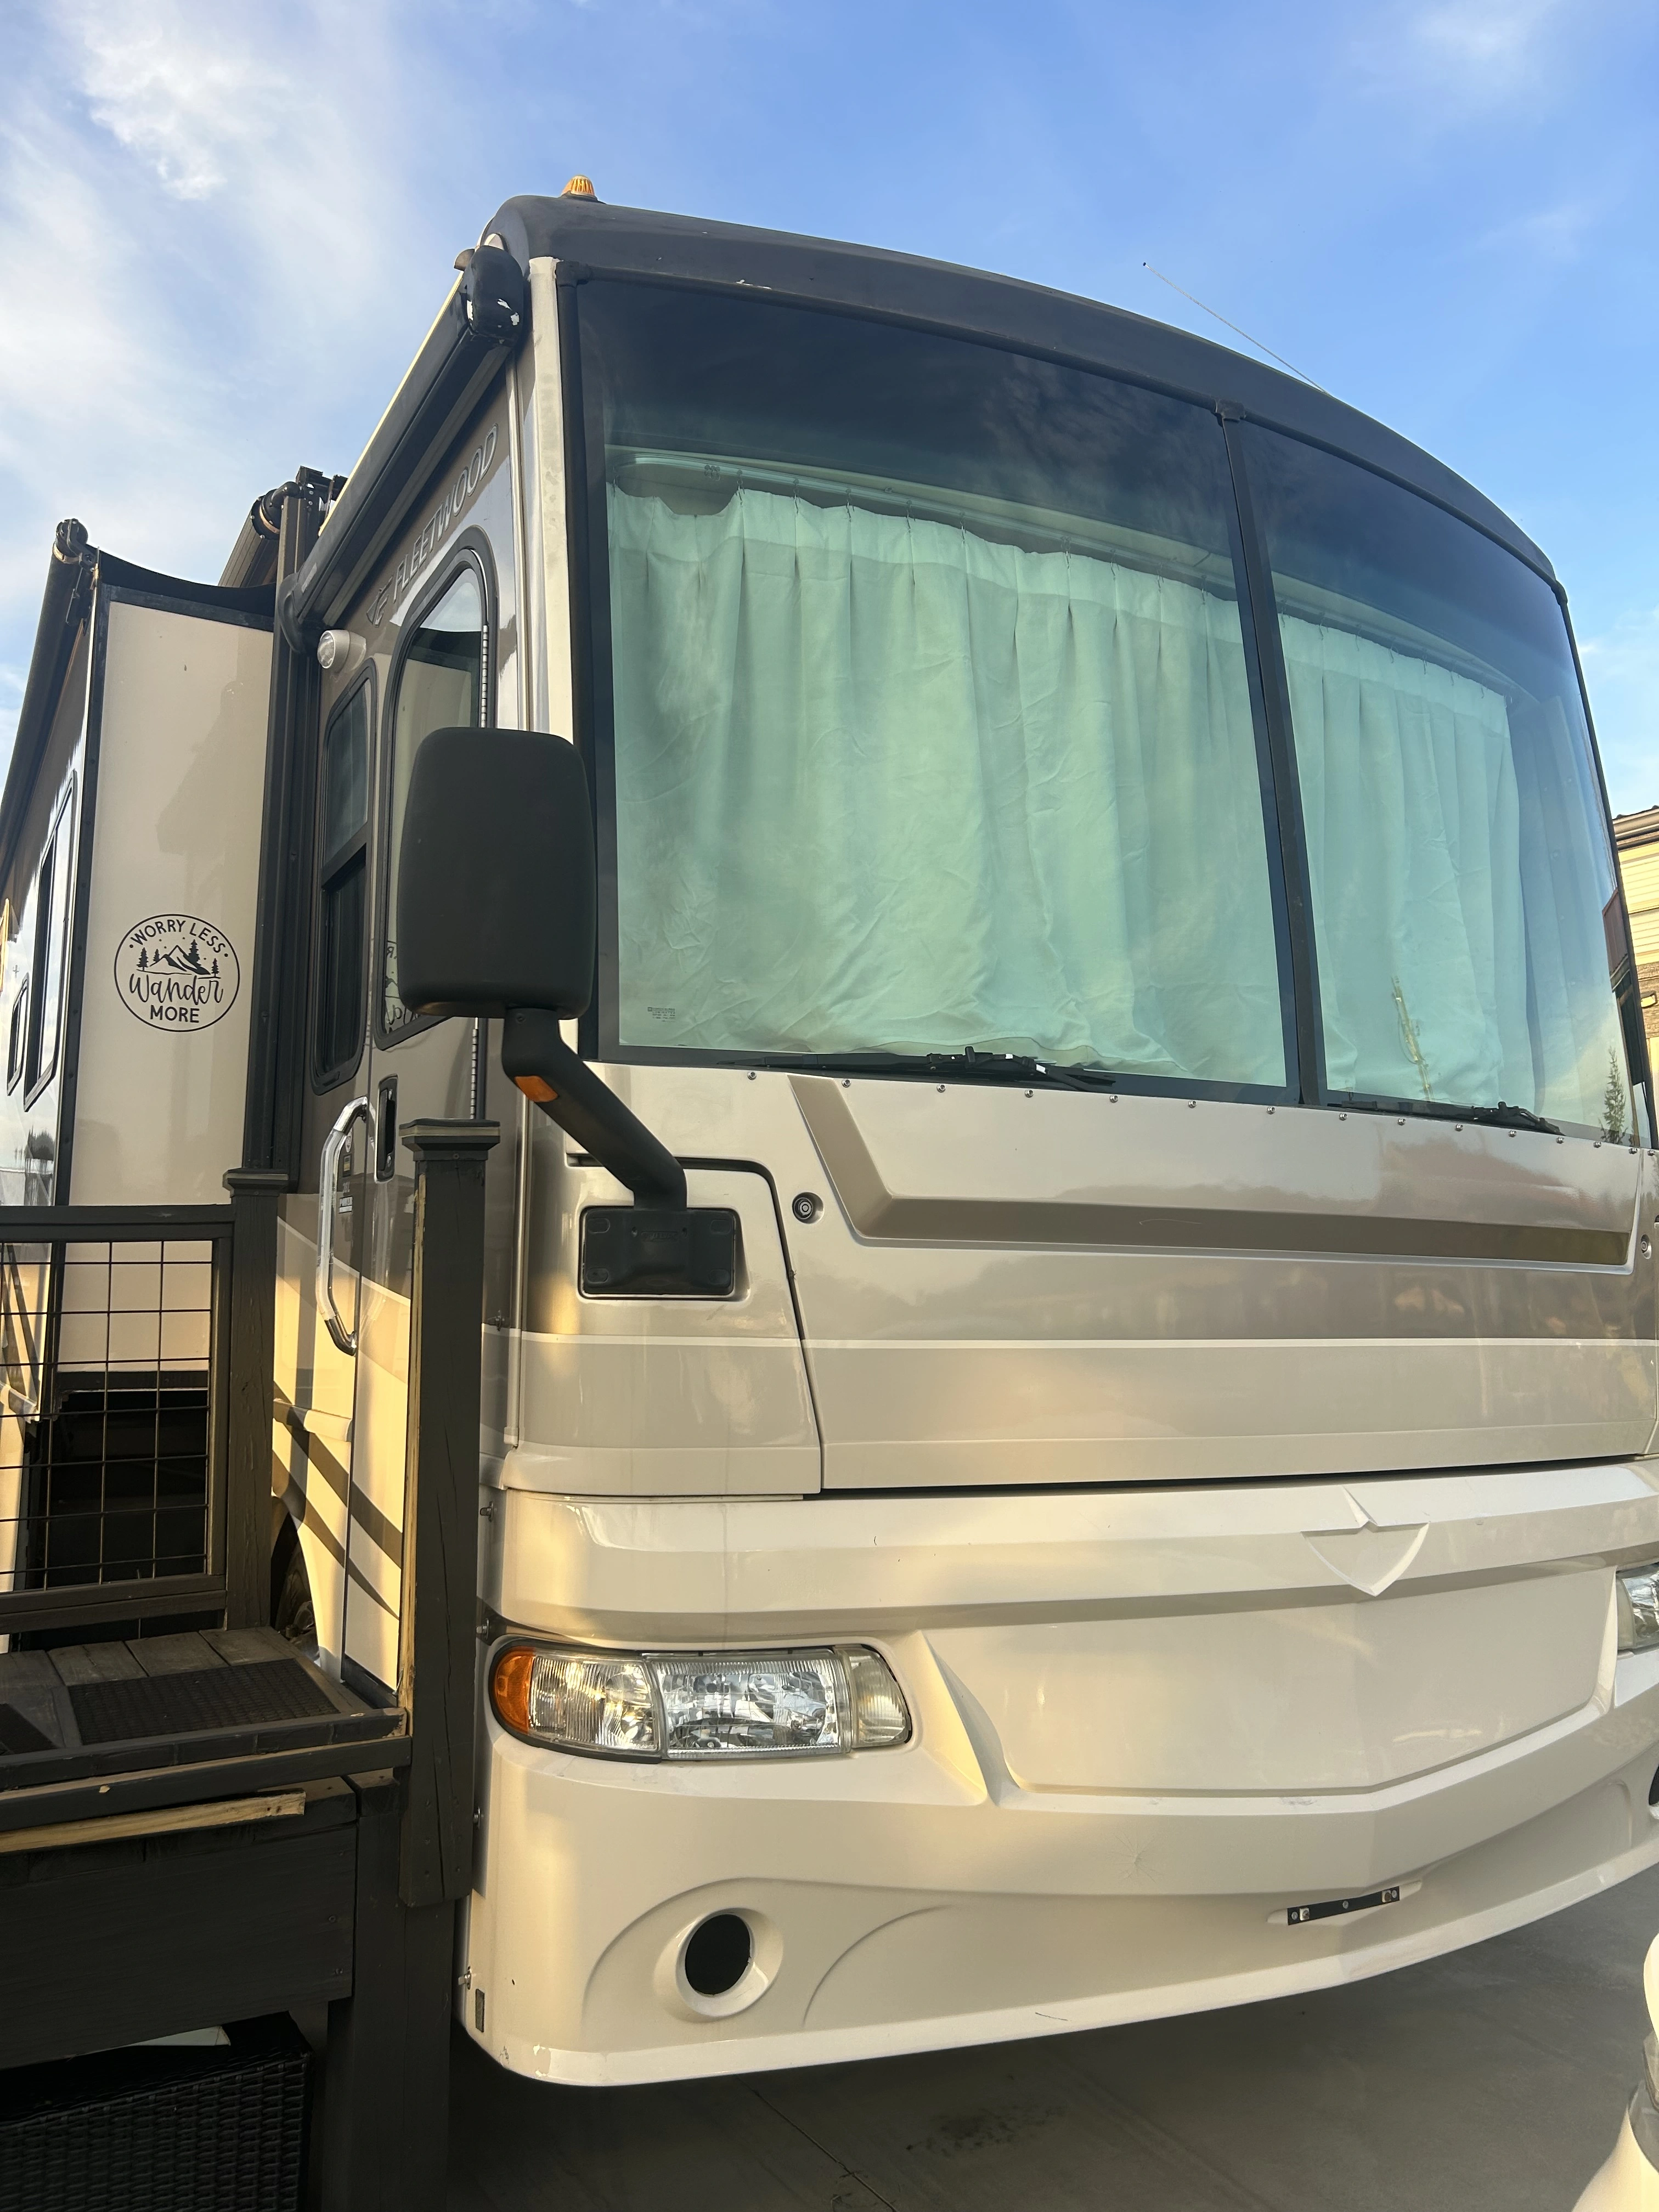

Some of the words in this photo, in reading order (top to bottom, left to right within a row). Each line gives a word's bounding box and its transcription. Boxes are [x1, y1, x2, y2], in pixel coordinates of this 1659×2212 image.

[393, 424, 499, 604] FLEETWOOD
[130, 919, 186, 945] WORRY
[189, 922, 226, 953] LESS
[129, 973, 224, 1006] Wander
[150, 1005, 200, 1023] MORE
